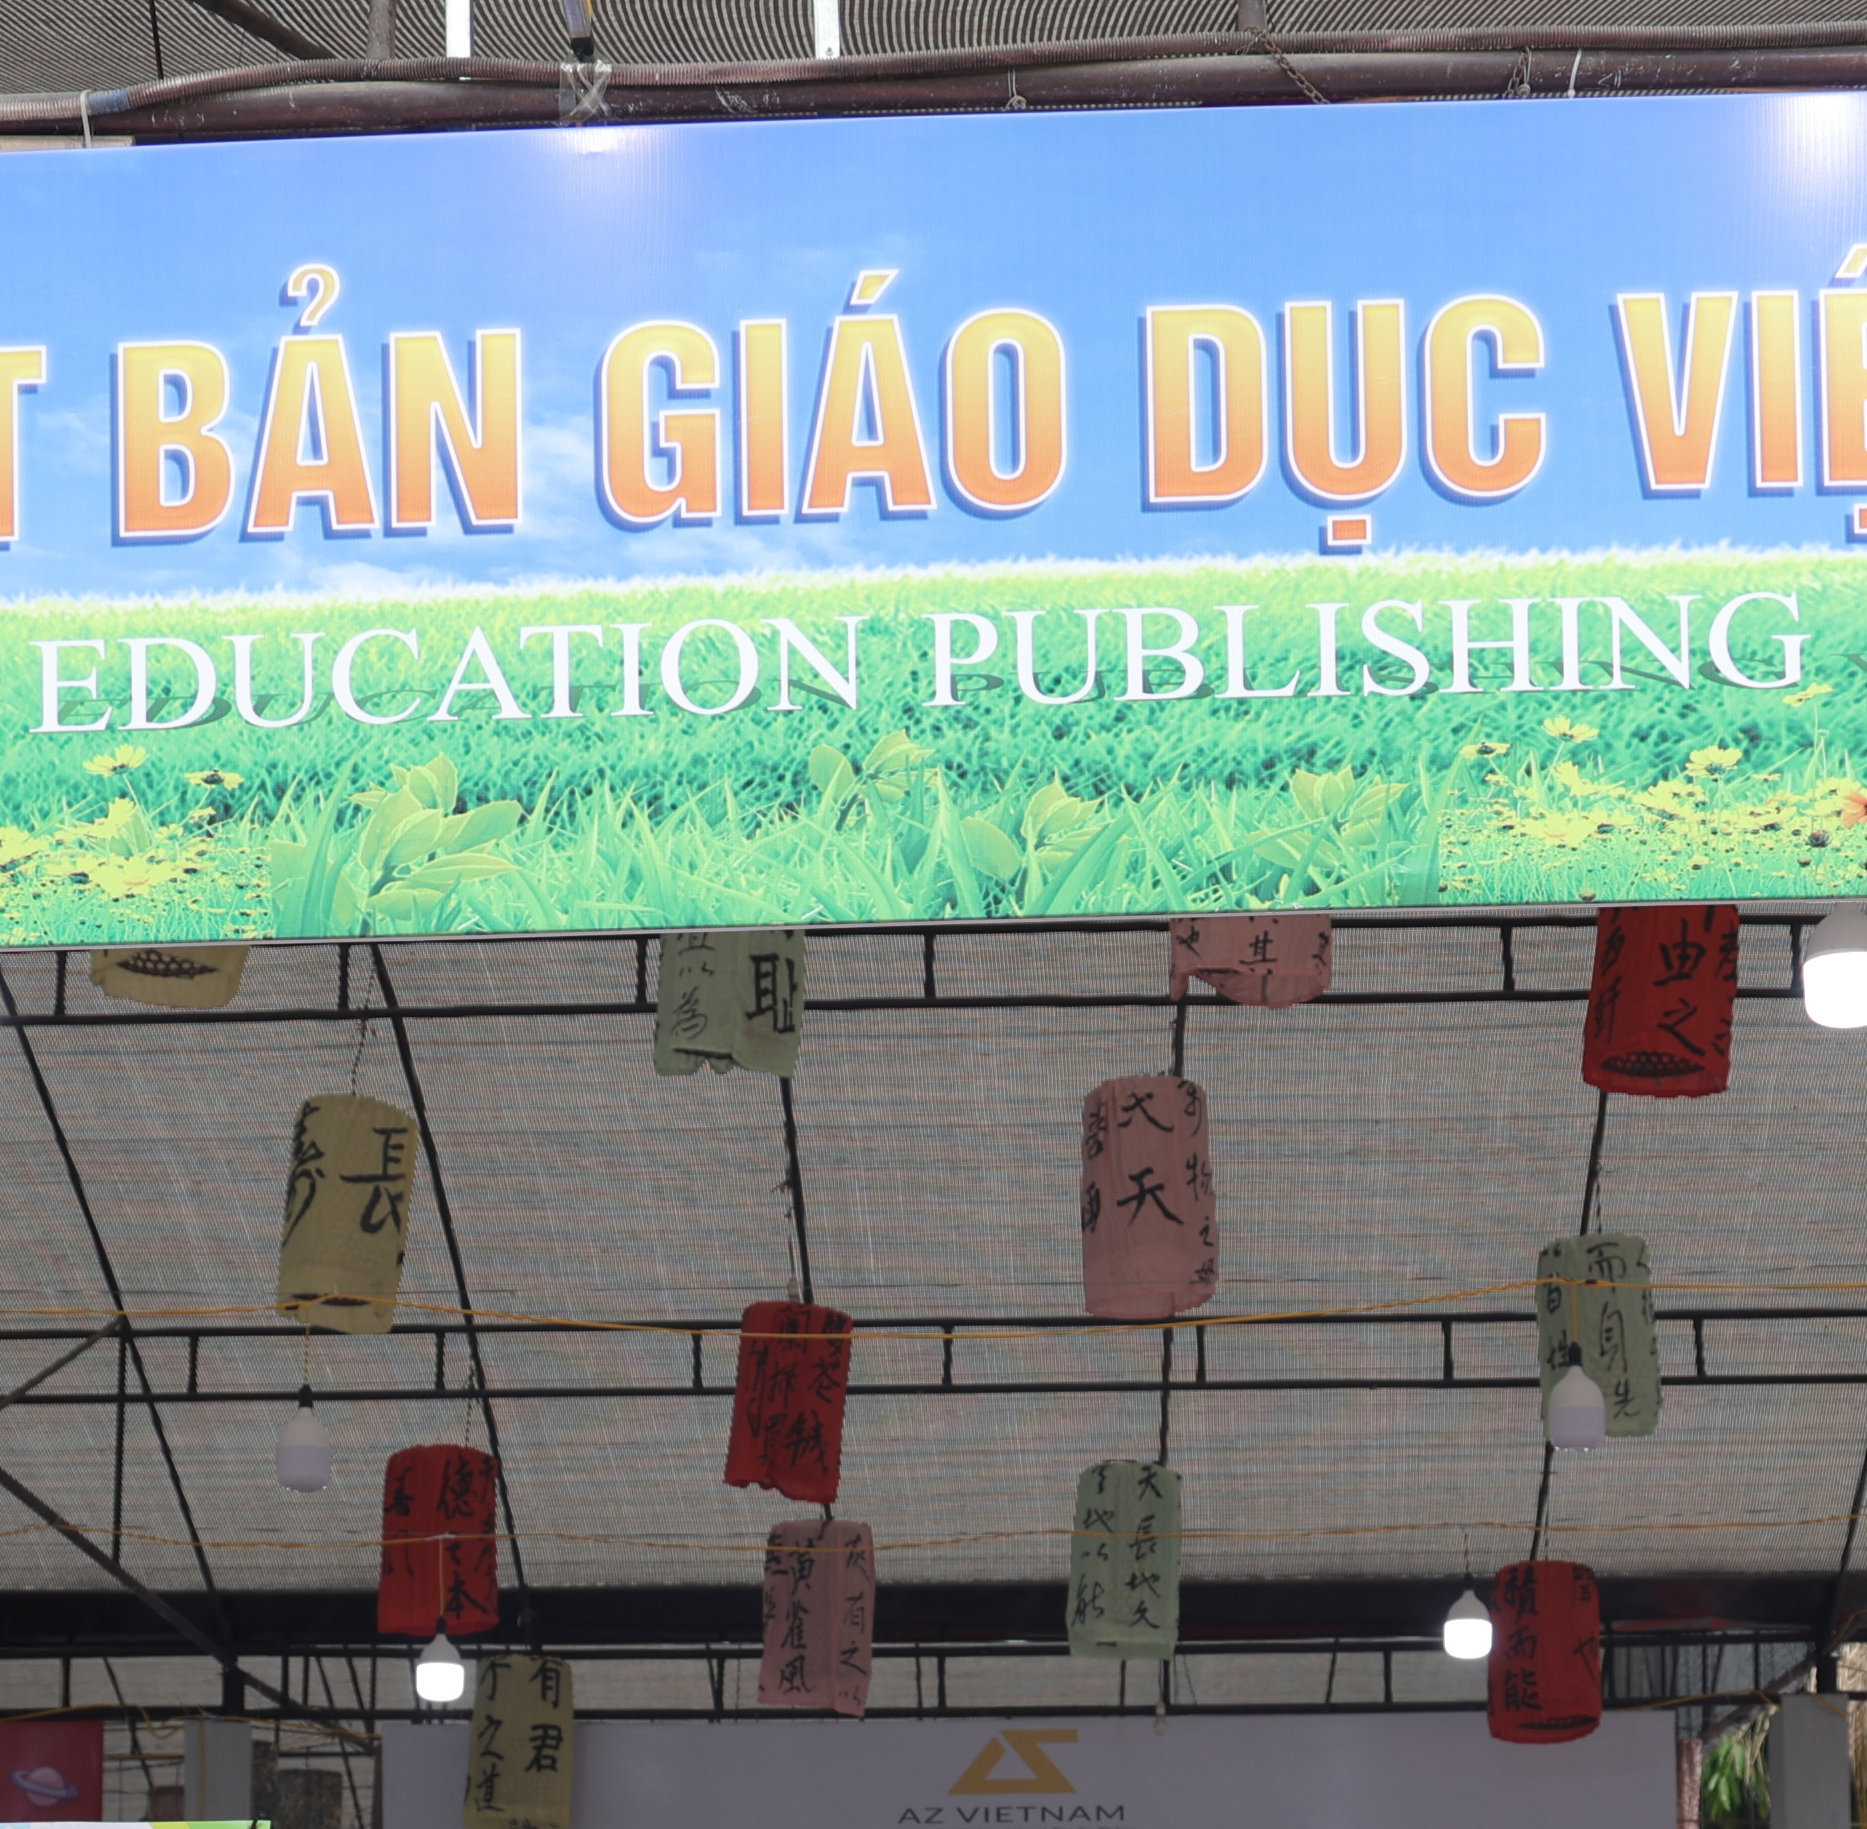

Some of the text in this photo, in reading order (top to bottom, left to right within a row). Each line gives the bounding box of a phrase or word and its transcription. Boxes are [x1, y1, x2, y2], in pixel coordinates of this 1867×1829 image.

[114, 260, 524, 545] BẢN
[596, 265, 1069, 526] GIÁO
[1143, 293, 1548, 555] DỤC
[29, 615, 868, 735] EDUCATION
[925, 590, 1806, 708] PUBLISHING
[897, 1804, 1126, 1824] AZ VIETNAM
